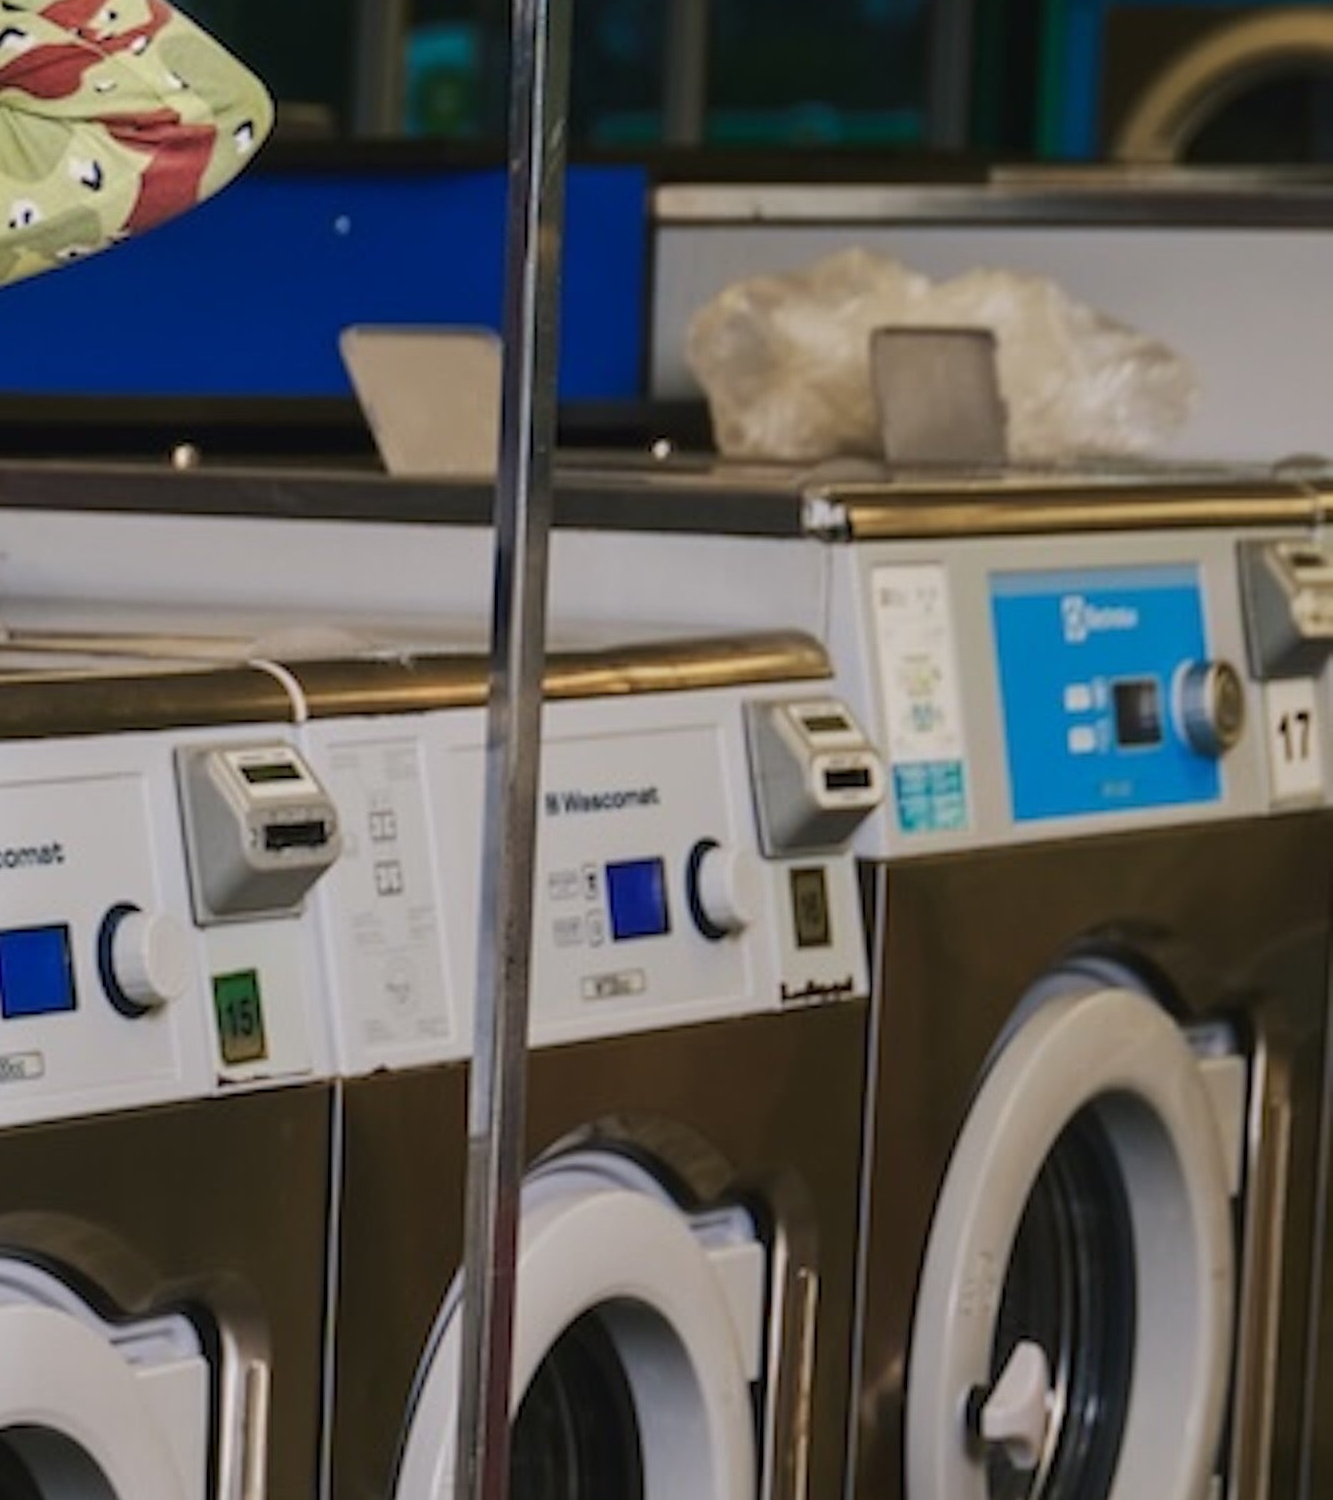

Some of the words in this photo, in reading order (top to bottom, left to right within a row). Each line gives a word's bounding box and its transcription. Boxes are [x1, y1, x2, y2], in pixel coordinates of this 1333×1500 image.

[1278, 711, 1310, 762] 17
[561, 783, 661, 814] Wascomat
[226, 999, 255, 1037] 15
